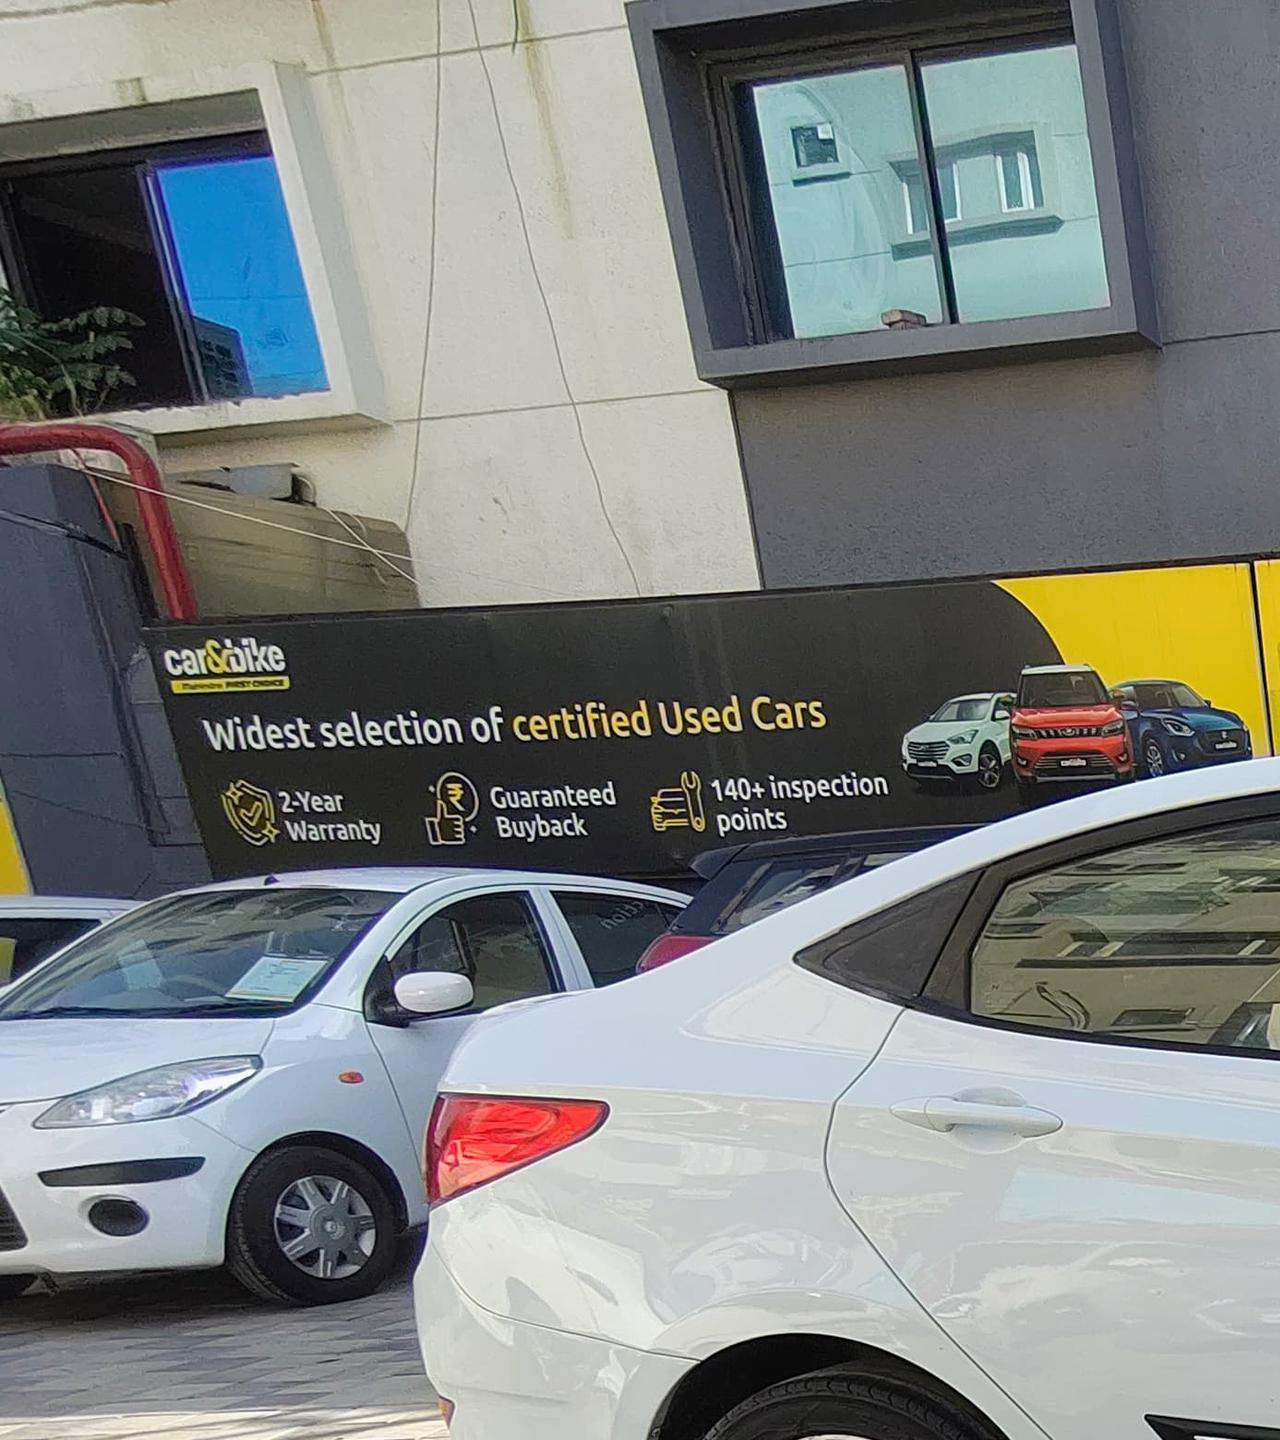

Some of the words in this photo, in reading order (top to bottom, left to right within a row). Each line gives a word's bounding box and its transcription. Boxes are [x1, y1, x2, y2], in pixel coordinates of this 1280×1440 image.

[164, 637, 287, 675] car&bike
[201, 714, 316, 751] Widest
[319, 708, 464, 747] selection
[470, 705, 504, 743] of
[512, 700, 653, 742] certified
[657, 694, 744, 736] Used
[751, 695, 828, 731] Cars
[278, 791, 344, 814] 2-Year
[490, 780, 617, 809] Guaranteed
[710, 776, 766, 801] 140+
[770, 772, 890, 803] inspection
[285, 819, 381, 845] Warranty
[495, 812, 589, 843] Buyback
[715, 807, 788, 837] points
